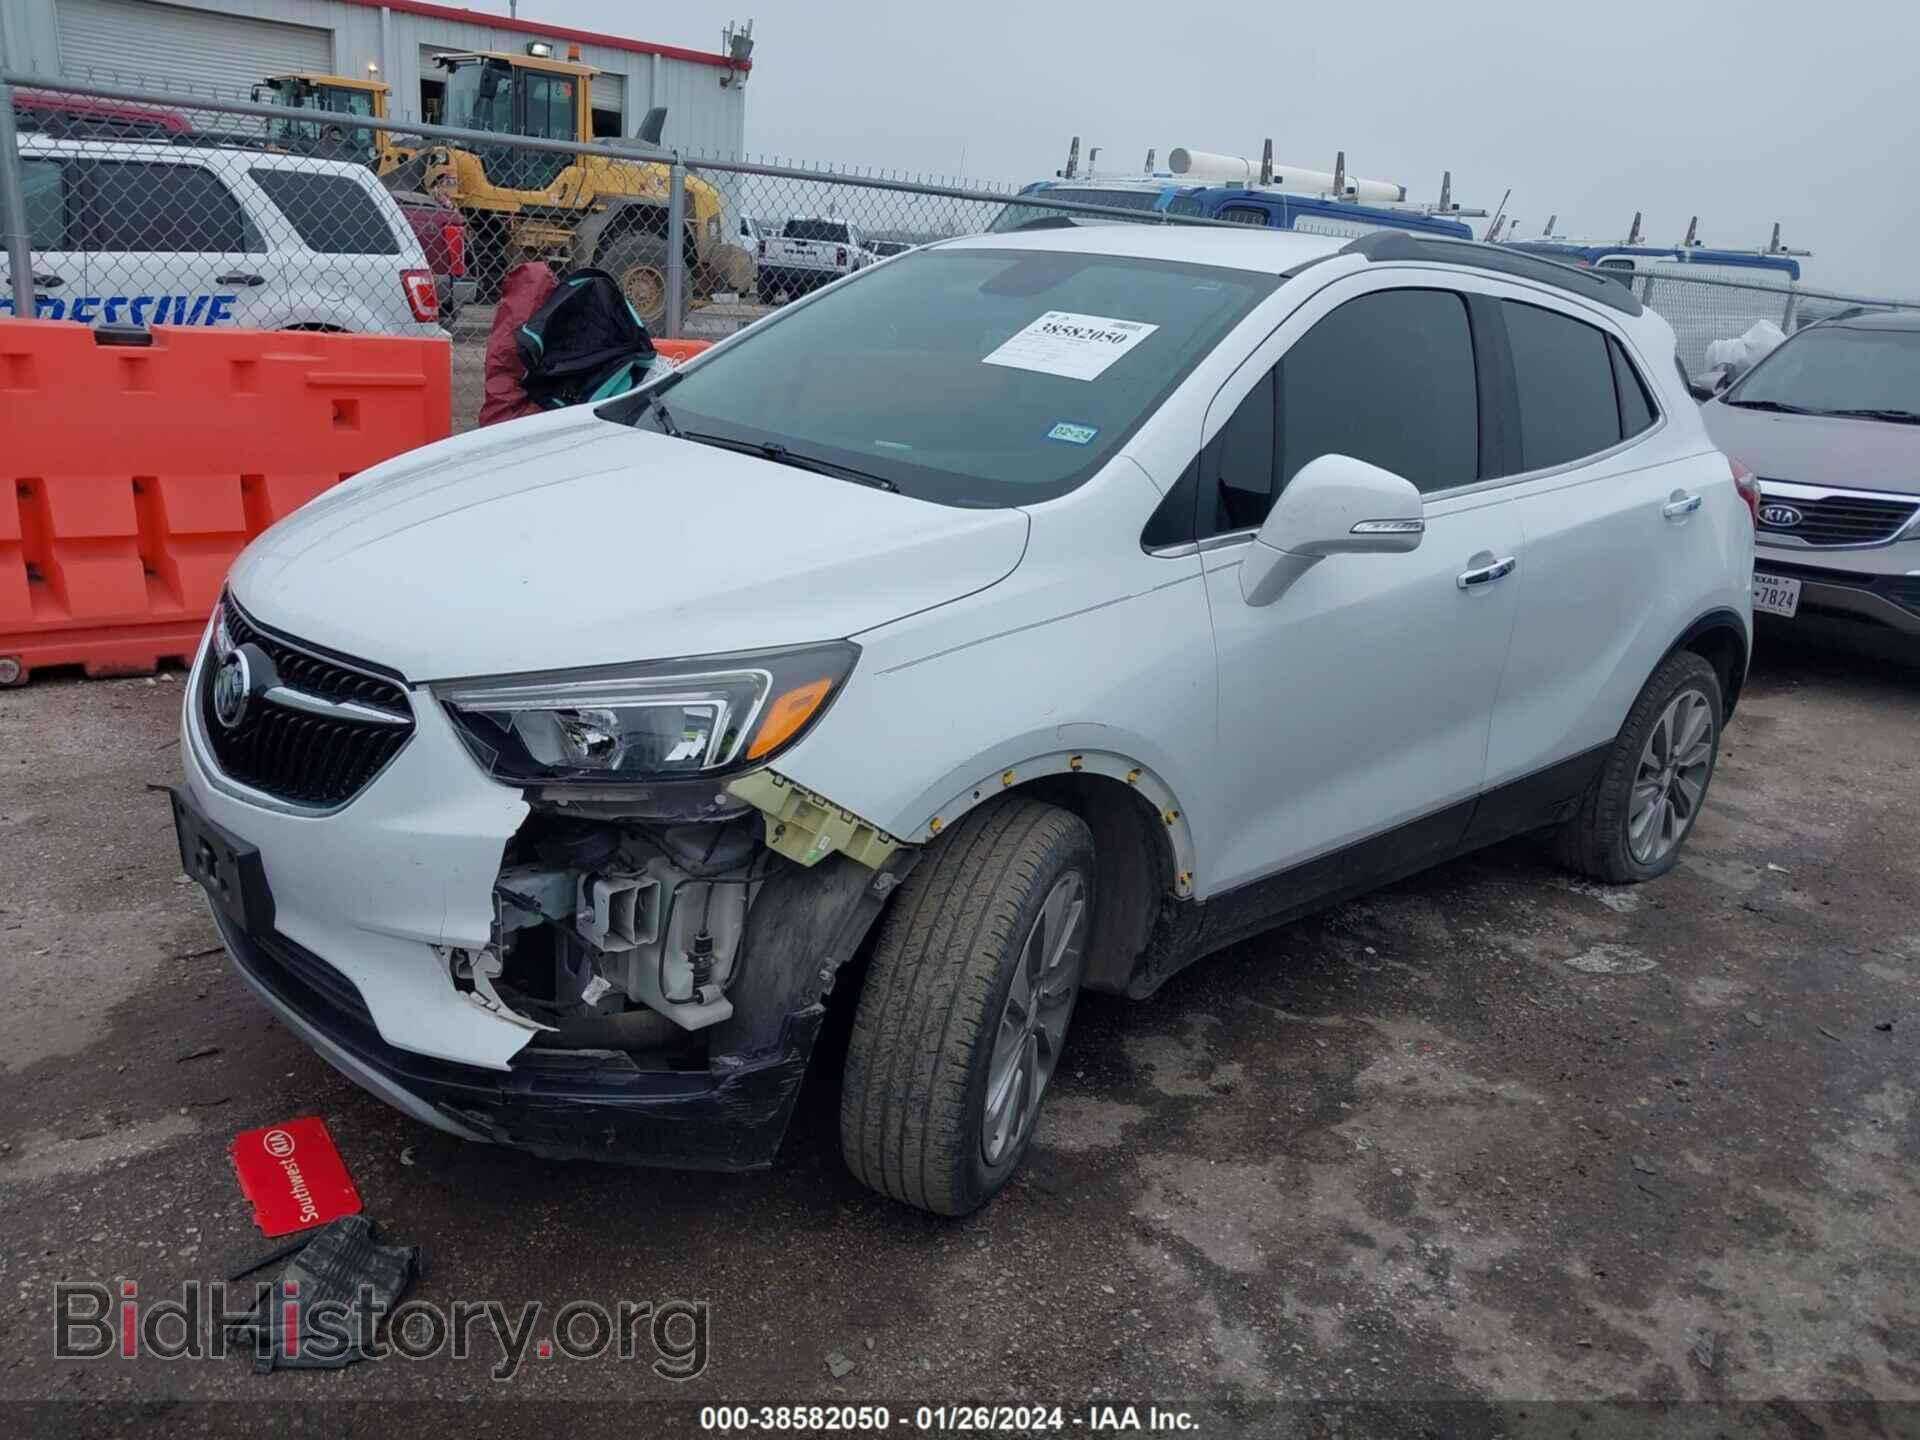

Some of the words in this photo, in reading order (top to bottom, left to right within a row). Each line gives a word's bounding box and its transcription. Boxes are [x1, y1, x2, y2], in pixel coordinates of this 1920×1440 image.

[1036, 322, 1128, 344] 38582050
[1764, 509, 1793, 523] KIA
[1752, 575, 1778, 585] EXAS
[1760, 587, 1794, 609] 7824
[279, 1157, 320, 1223] Southwest
